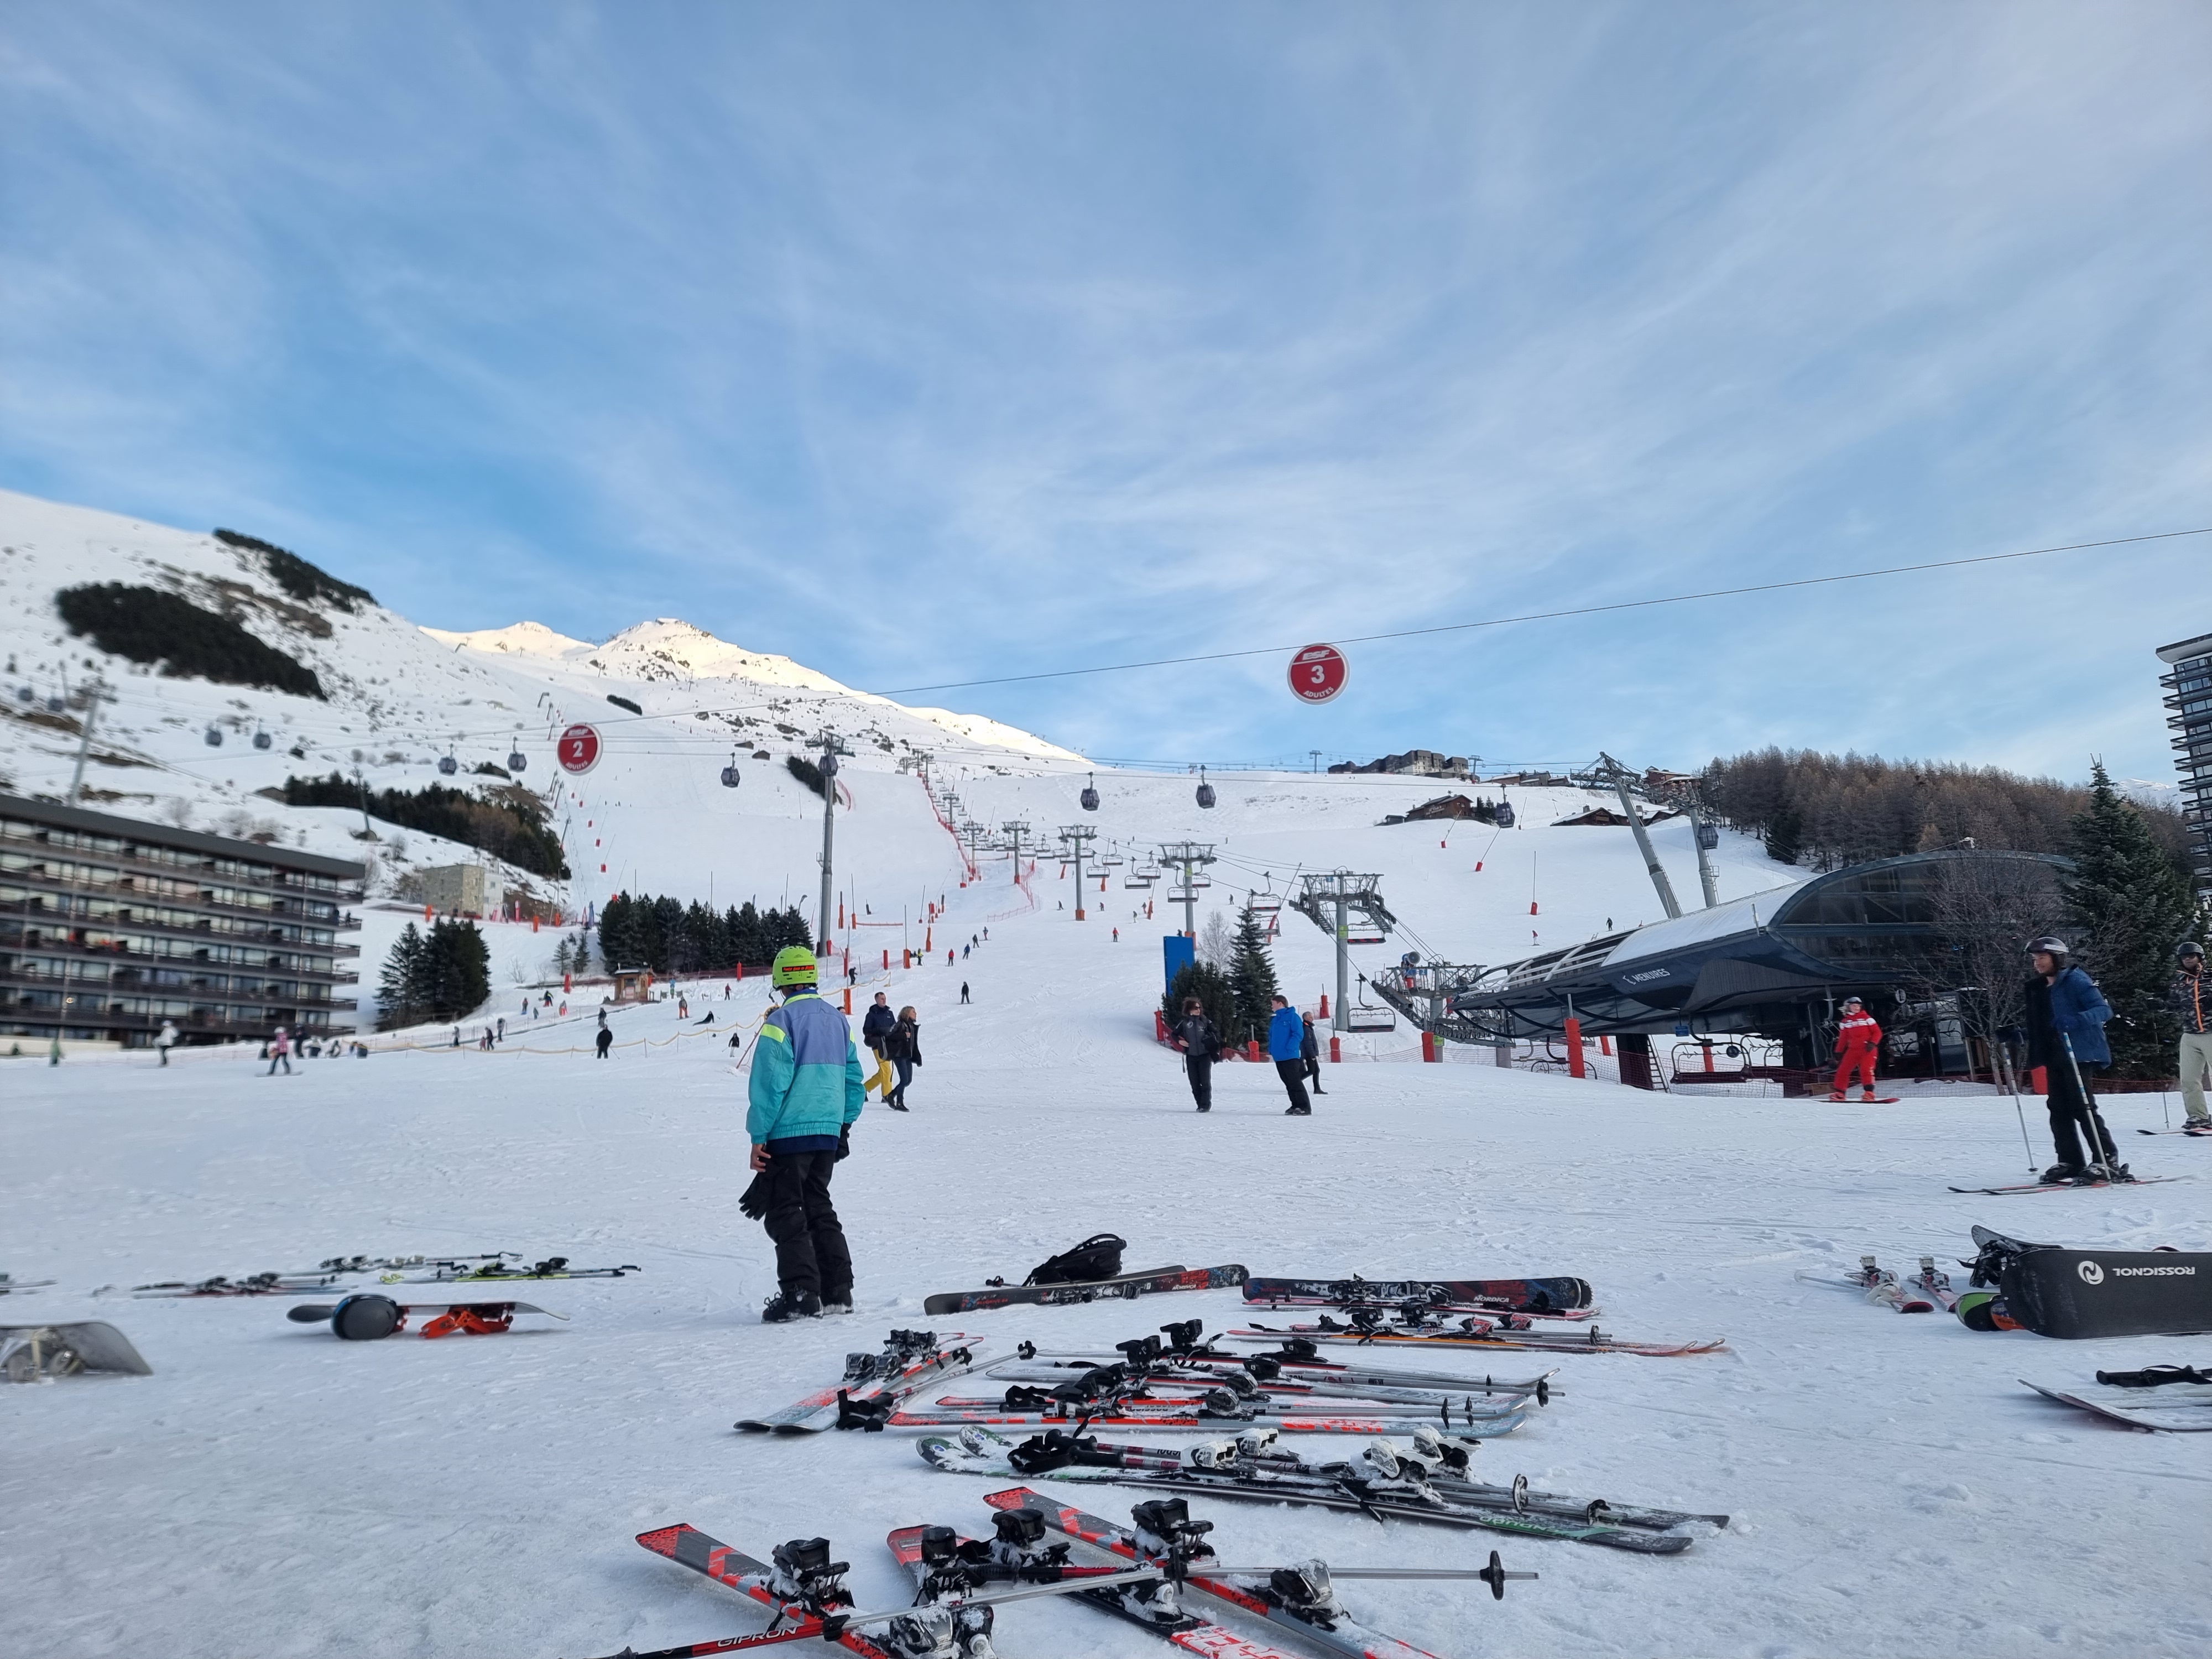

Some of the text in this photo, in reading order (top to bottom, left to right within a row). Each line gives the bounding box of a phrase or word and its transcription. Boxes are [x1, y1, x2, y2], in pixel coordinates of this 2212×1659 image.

[1302, 649, 1330, 660] ESF
[1311, 665, 1325, 684] 3
[1303, 686, 1334, 698] ADULTES
[572, 740, 583, 758] 2
[1631, 968, 1671, 982] MENUIRES
[2112, 1266, 2195, 1276] ROSSIGNOL
[1473, 1295, 1510, 1303] NORDICA
[717, 1626, 797, 1647] GIPRON
